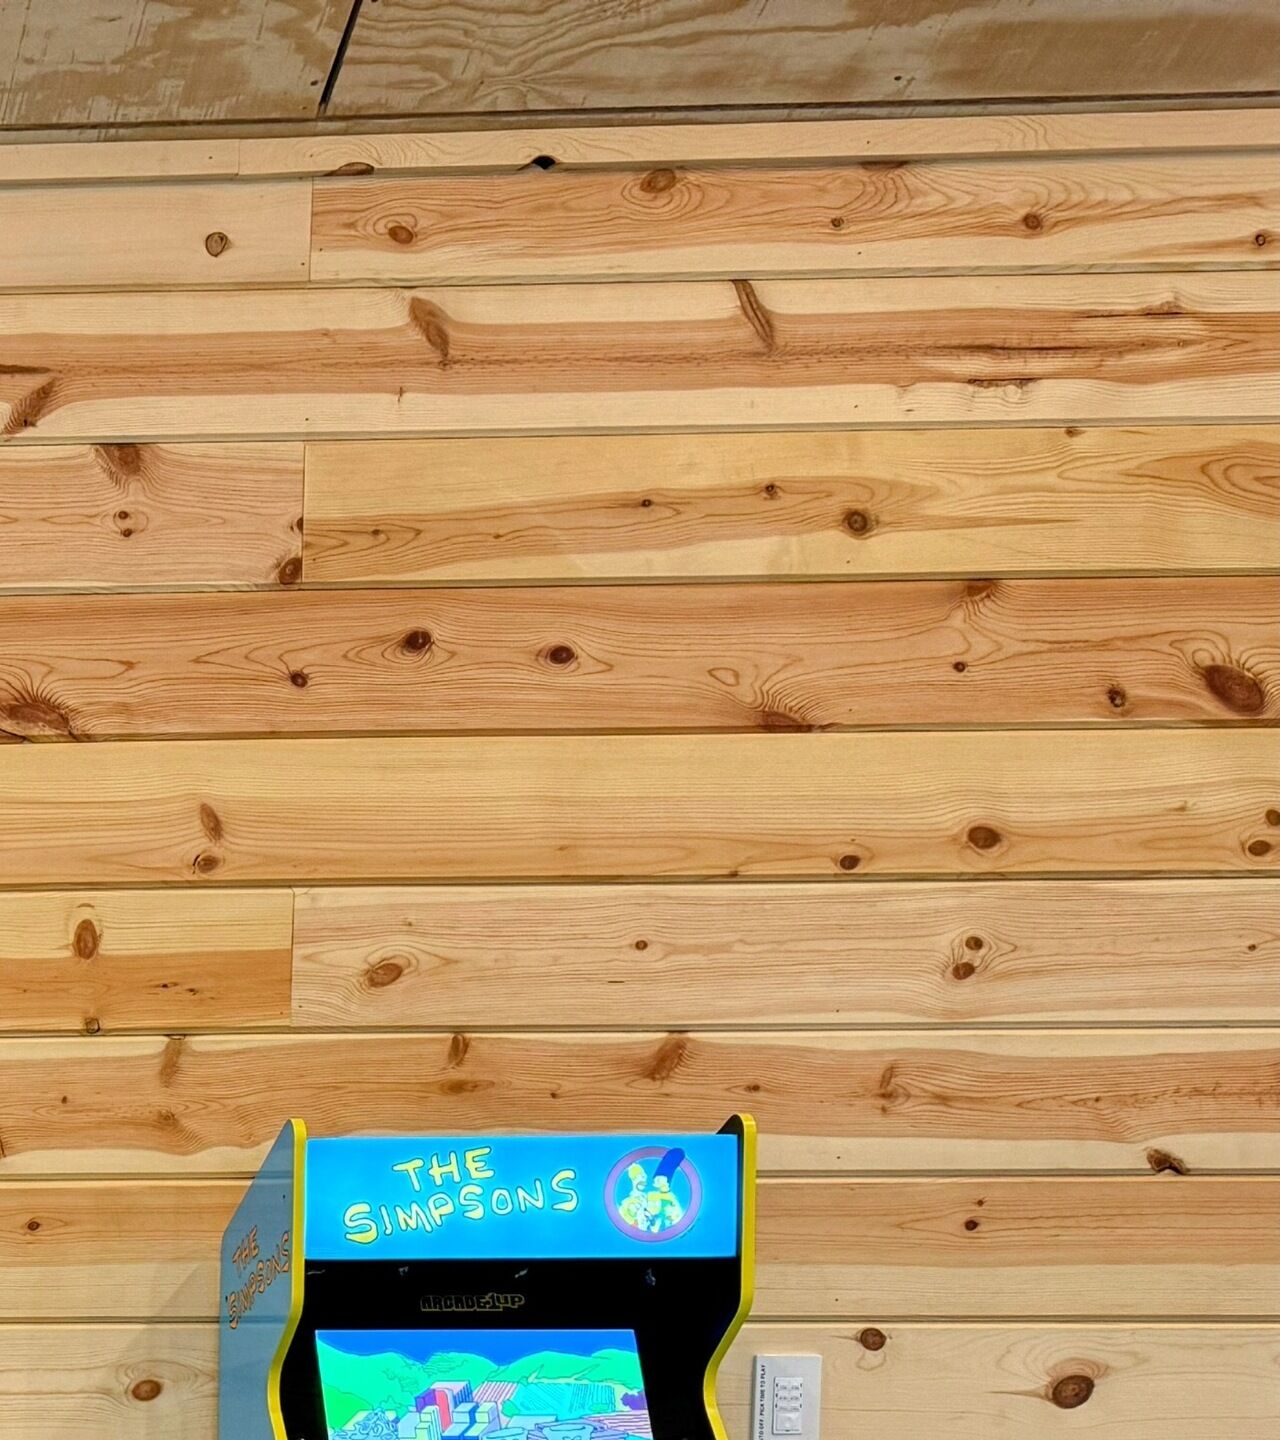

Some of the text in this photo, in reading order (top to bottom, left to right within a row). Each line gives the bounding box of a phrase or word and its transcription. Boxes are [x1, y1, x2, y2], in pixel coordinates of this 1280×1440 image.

[392, 1146, 496, 1192] THE
[343, 1168, 580, 1245] SIMPSONS
[229, 1230, 289, 1330] SIMPSONS
[232, 1224, 259, 1278] THE
